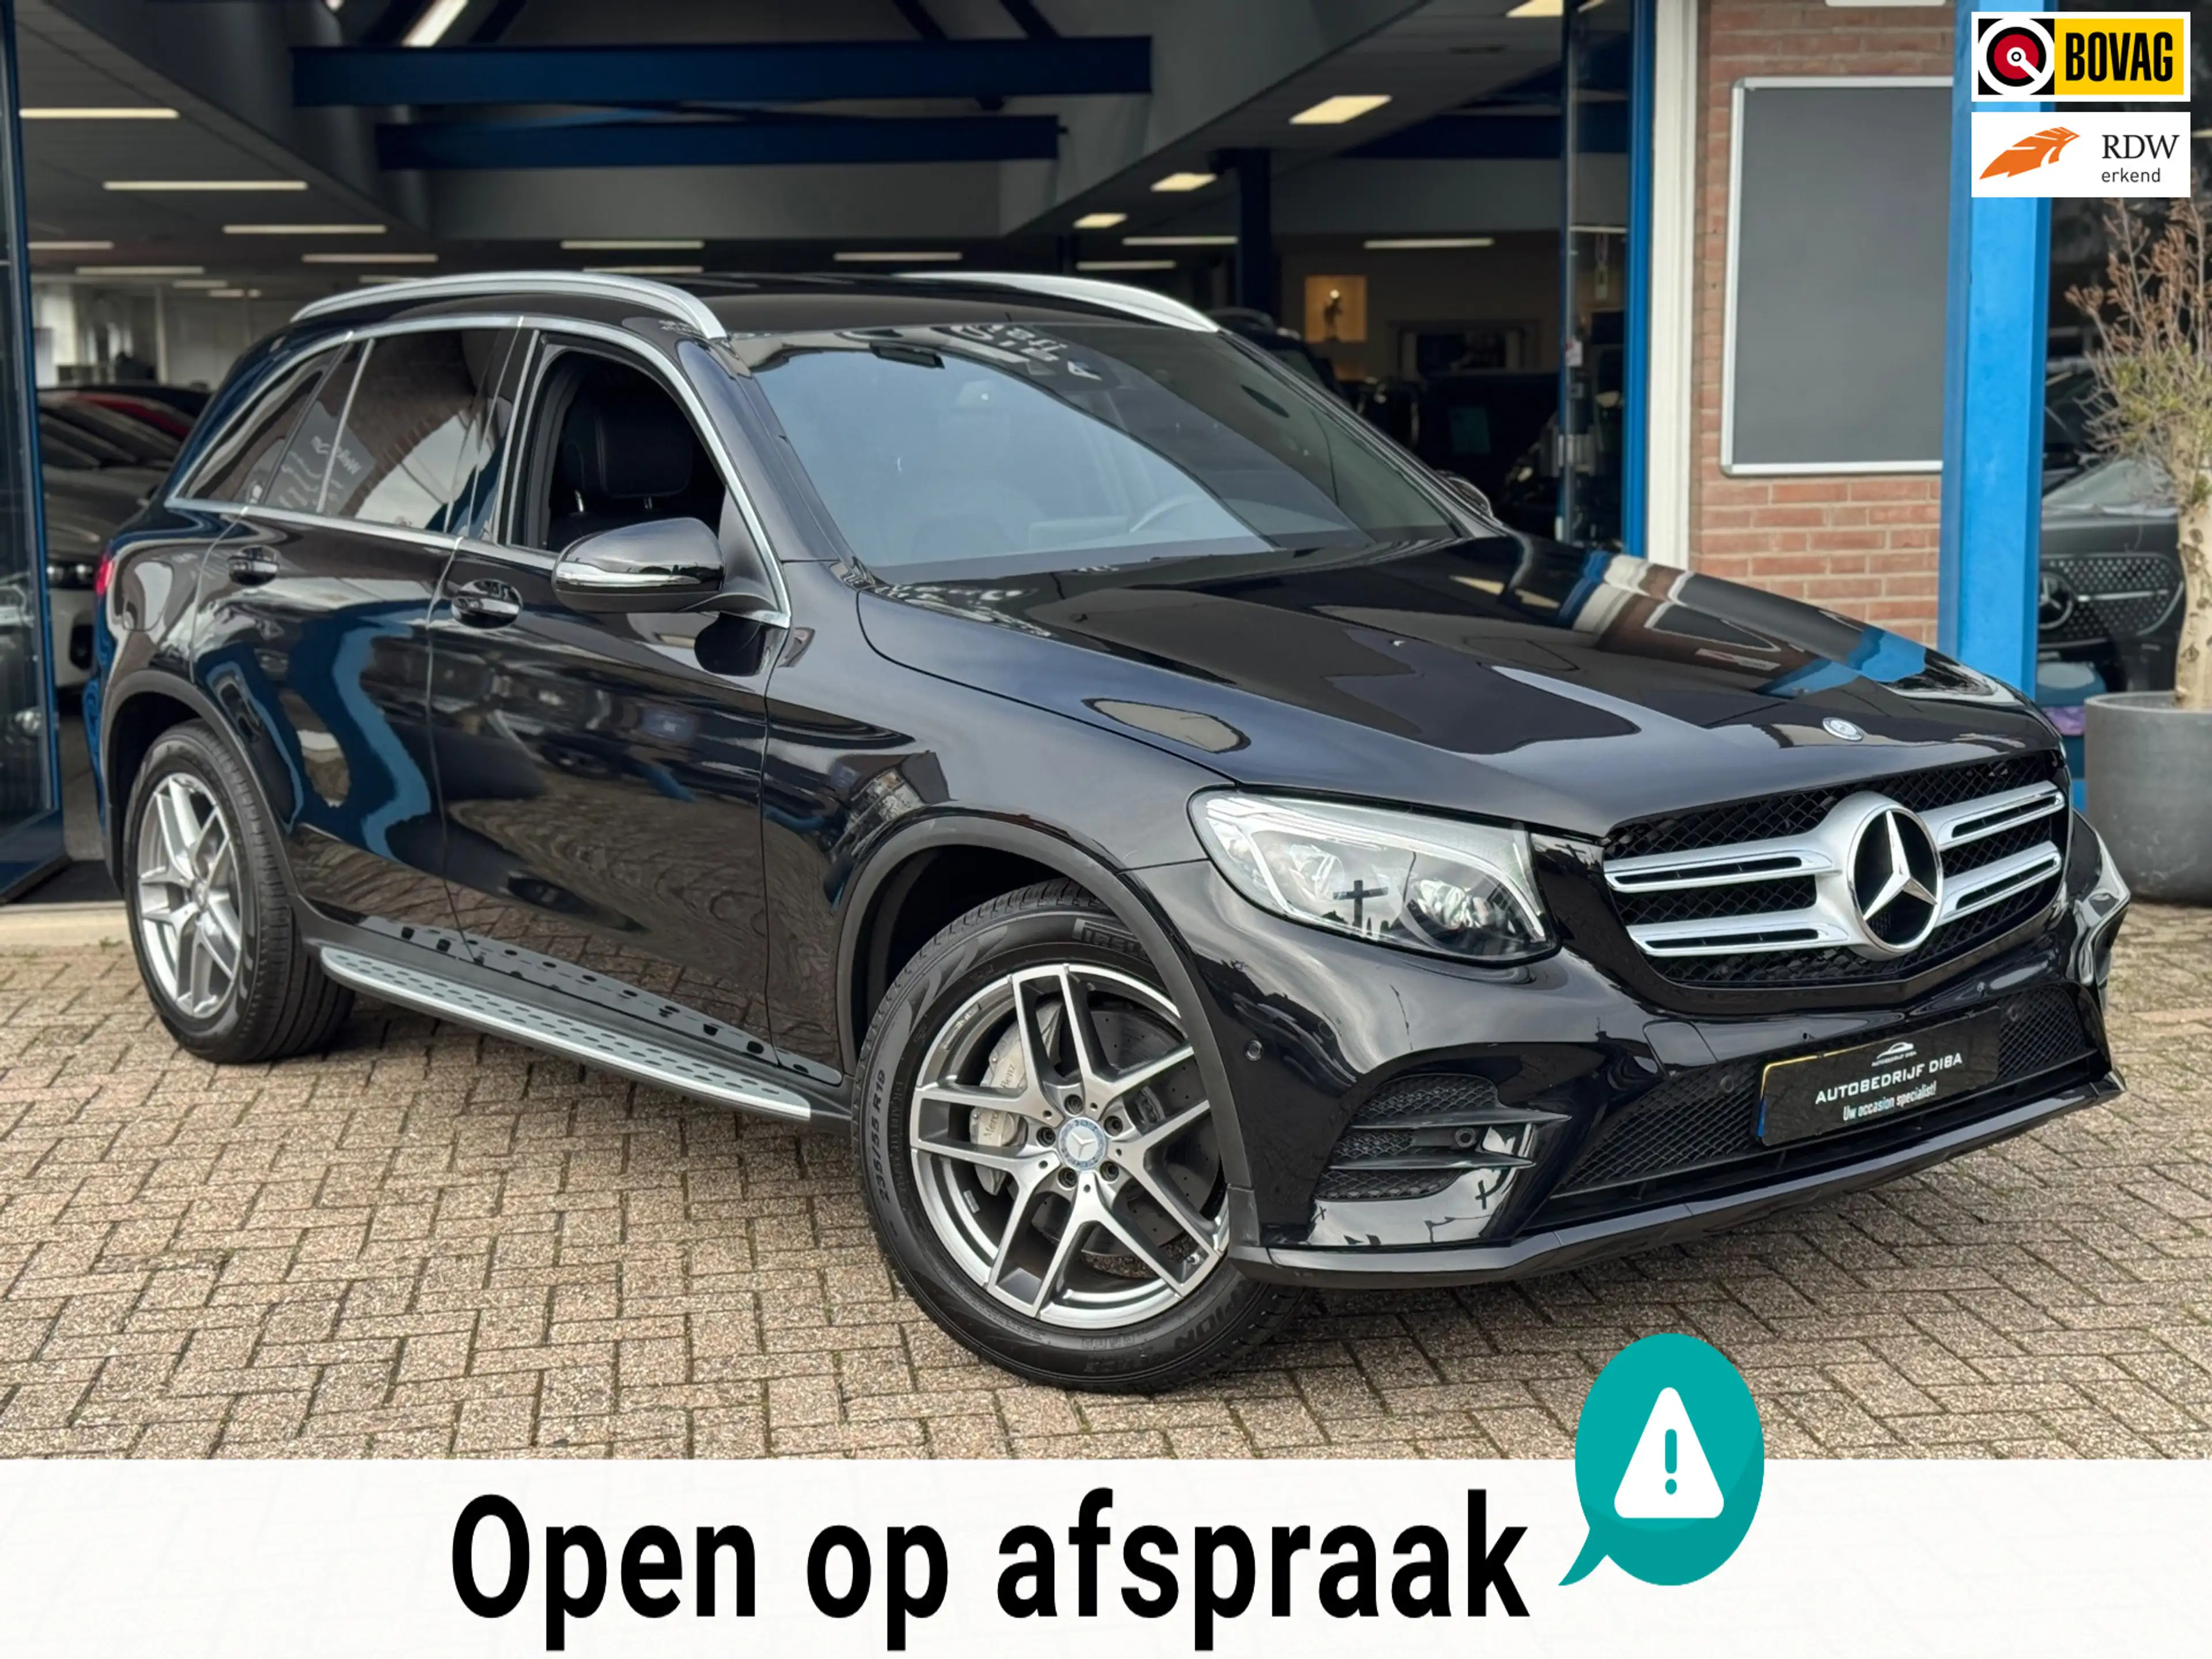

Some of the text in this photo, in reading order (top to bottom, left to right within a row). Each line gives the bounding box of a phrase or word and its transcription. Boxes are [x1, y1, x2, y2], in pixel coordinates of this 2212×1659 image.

[1815, 1052, 1963, 1104] AUTOBEDRIJF DIBA
[1843, 1080, 1937, 1121] Uw occasion specialist!
